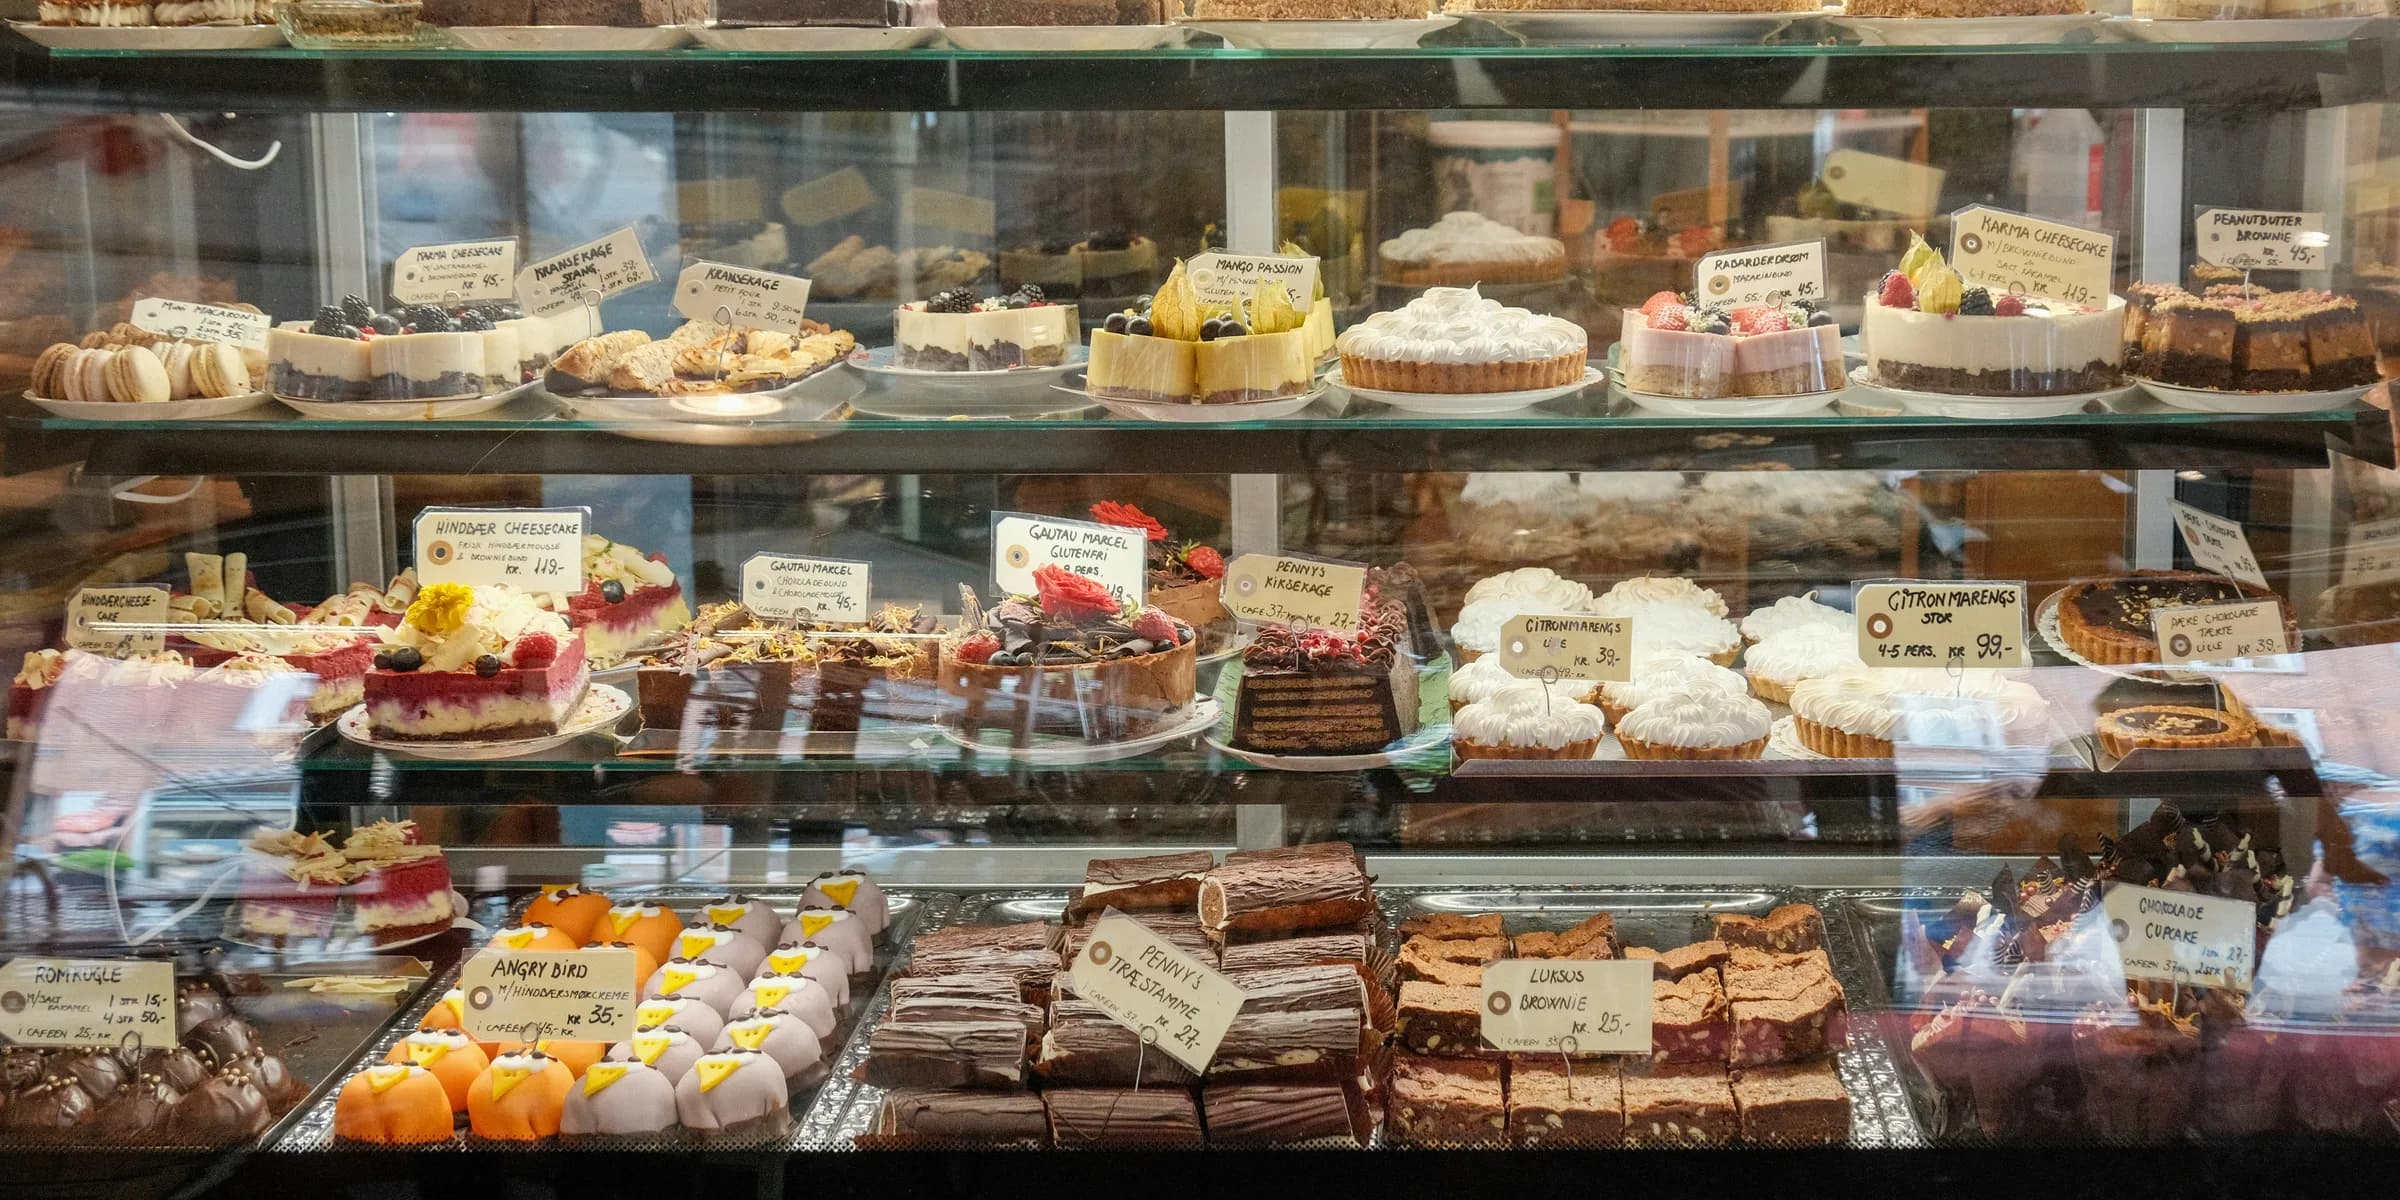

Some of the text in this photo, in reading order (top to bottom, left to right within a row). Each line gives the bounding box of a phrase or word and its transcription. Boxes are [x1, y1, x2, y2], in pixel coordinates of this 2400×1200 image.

[2213, 213, 2303, 226] PEANUTBUTTER
[1981, 215, 2109, 258] KARMA CHEESECAKE
[2236, 229, 2292, 243] BROWNIE
[417, 246, 504, 261] KARMA CHEESECAKE
[534, 243, 614, 281] KRANSEKAGE
[1715, 252, 1809, 270] RABARDERDRØM
[2289, 245, 2316, 264] 45,-
[1216, 259, 1303, 274] MANGO PASSION
[705, 268, 780, 290] KRANSEKAGE
[1798, 281, 1819, 296] 45,-
[436, 518, 580, 536] HINDBÆR CHEESECAKE
[458, 541, 561, 550] FRISK HINDBÆRMOUSSE
[1029, 525, 1129, 550] GAUTAU MARCEL
[1050, 545, 1109, 561] GLUTENFRI
[770, 561, 852, 576] GAUTAU MARCEL
[1264, 576, 1334, 597] KIKSEKAGE
[836, 595, 857, 611] 45,-
[1242, 606, 1266, 616] CAFE
[1921, 612, 1952, 624] STOR
[2171, 606, 2259, 630] PÆRE CHOKOLADE
[2199, 626, 2233, 638] TÆRTE
[1878, 633, 2014, 660] 4-5 PERS. KR 99,-
[2237, 644, 2251, 657] KR
[2139, 897, 2204, 920] CHOKOLADE
[2145, 922, 2199, 944] CUPCAKE
[35, 966, 122, 985] ROMKUGLE
[491, 958, 587, 981] ANGRY BIRD
[1530, 968, 1585, 984] LUKSUS
[1108, 956, 1200, 1021] TRÆSTAMME
[1519, 993, 1588, 1011] BROWNIE
[567, 1004, 624, 1026] KR 35,-
[1598, 1011, 1631, 1036] 25,-
[26, 1028, 67, 1037] CAFEEN
